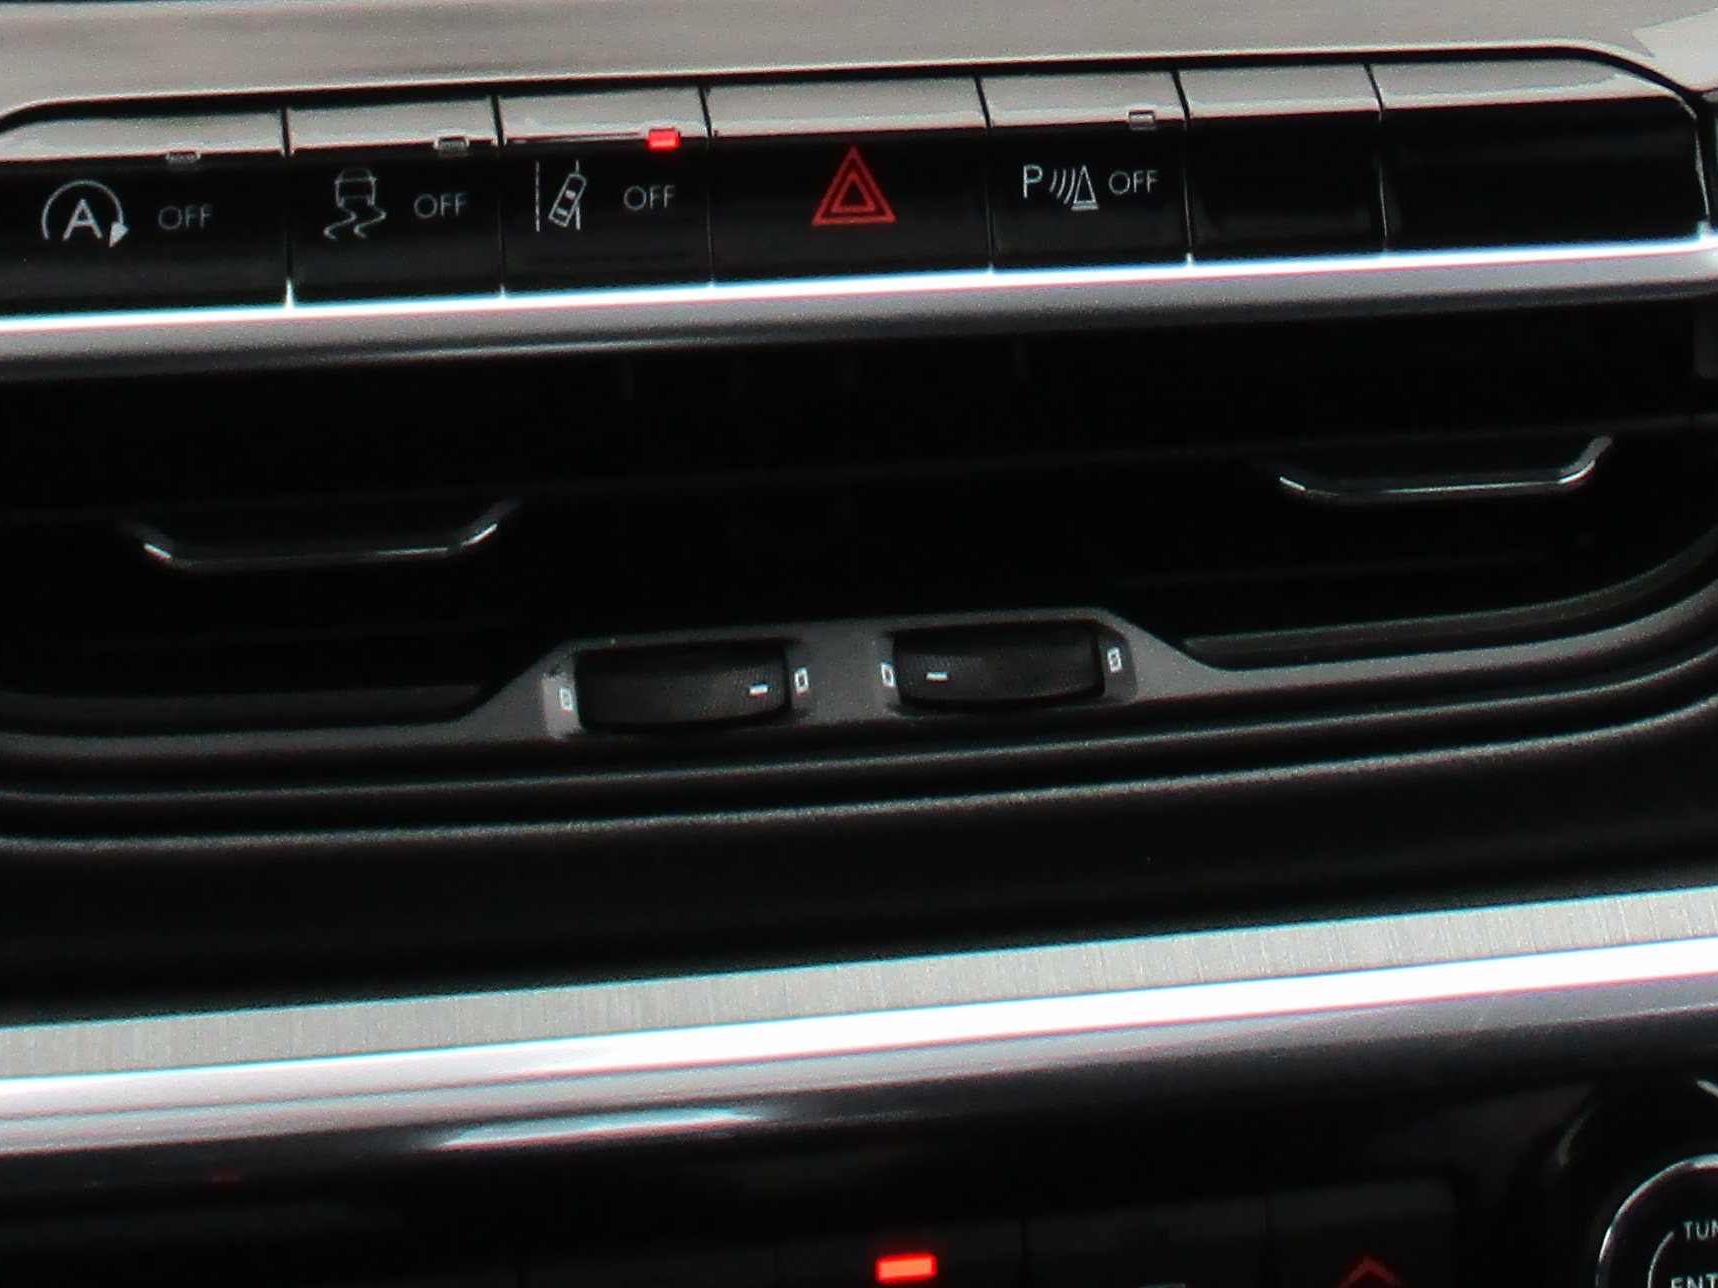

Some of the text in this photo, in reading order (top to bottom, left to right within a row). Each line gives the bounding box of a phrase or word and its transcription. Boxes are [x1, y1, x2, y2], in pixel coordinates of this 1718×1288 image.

[1022, 165, 1157, 198] P OFF
[414, 193, 467, 219] OFF
[624, 183, 676, 211] OFF
[158, 203, 211, 230] OFF
